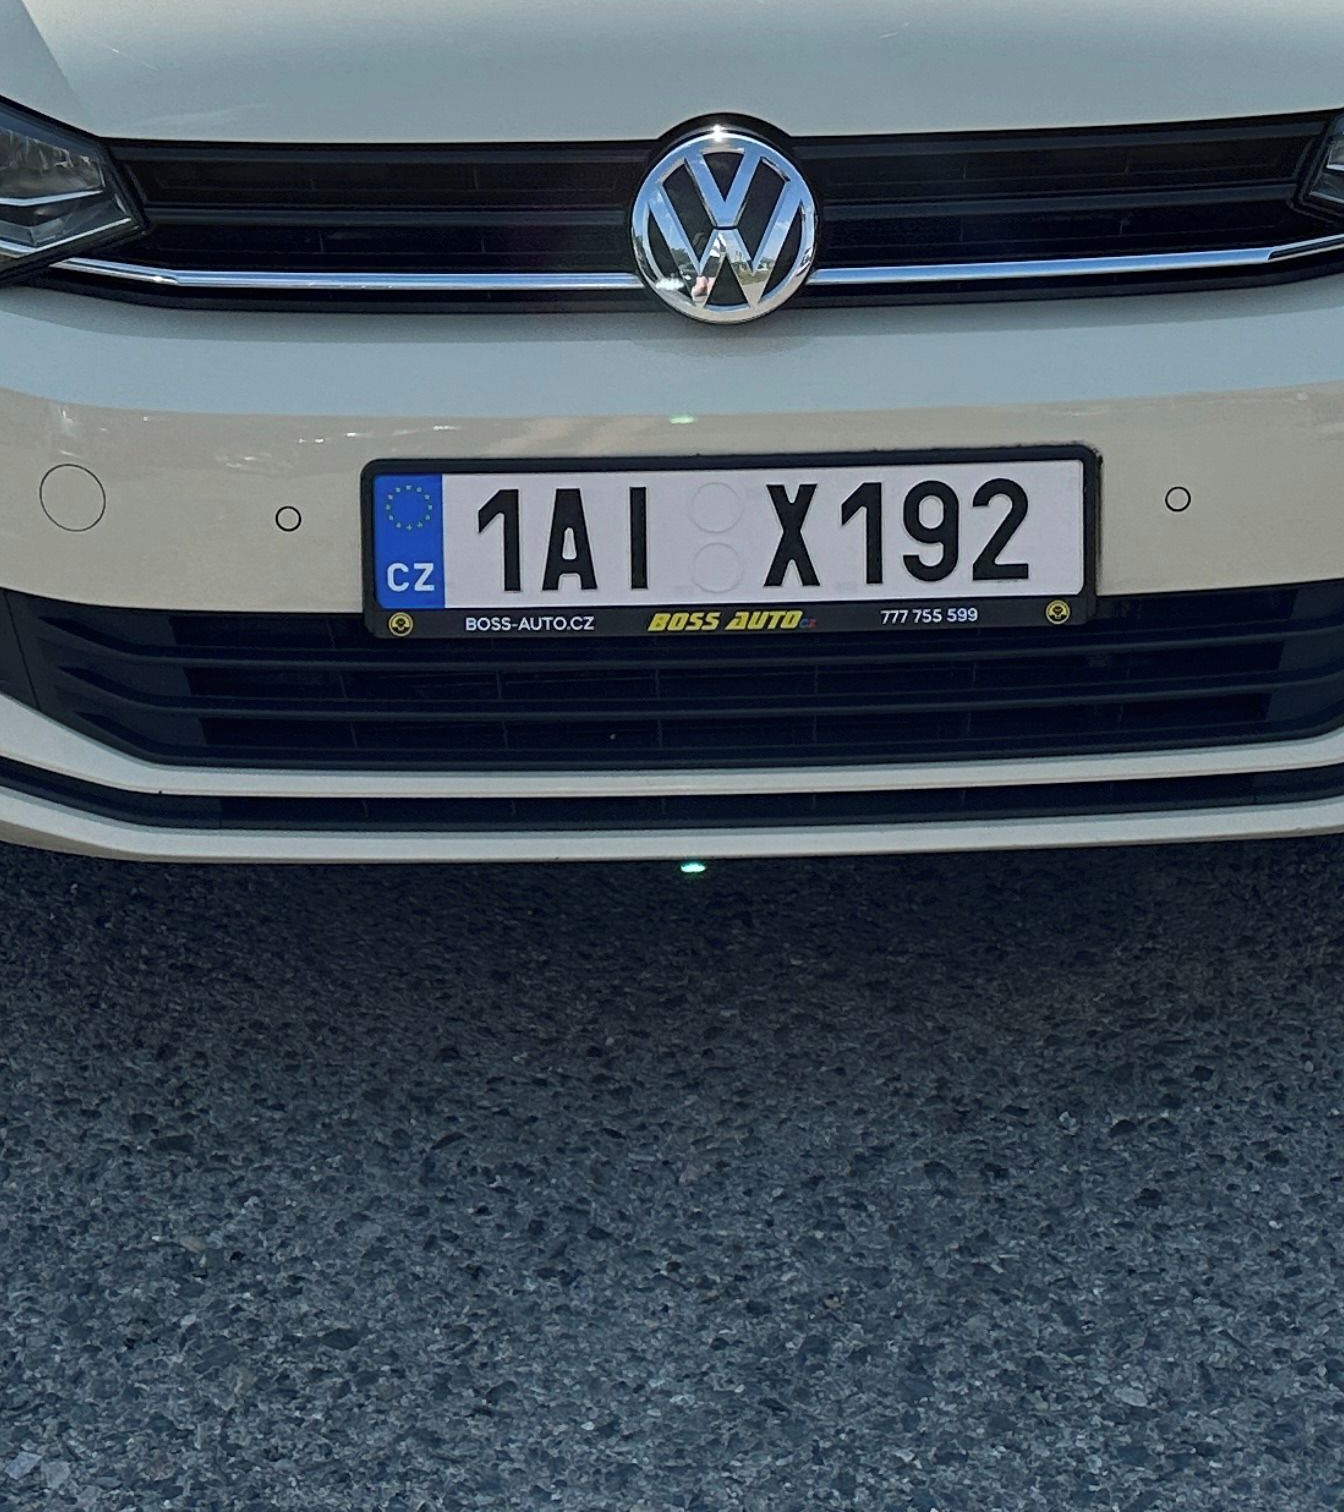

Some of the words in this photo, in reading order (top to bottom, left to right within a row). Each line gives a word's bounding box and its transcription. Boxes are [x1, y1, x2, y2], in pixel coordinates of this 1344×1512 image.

[477, 486, 649, 593] 1AI
[762, 477, 1030, 588] X192
[386, 562, 436, 593] CZ
[464, 615, 596, 632] BOSS-AUTO.CZ
[647, 611, 722, 632] BOSS
[724, 610, 804, 631] AUTO
[880, 609, 909, 625] 777
[912, 609, 943, 624] 755
[946, 607, 979, 623] 599
